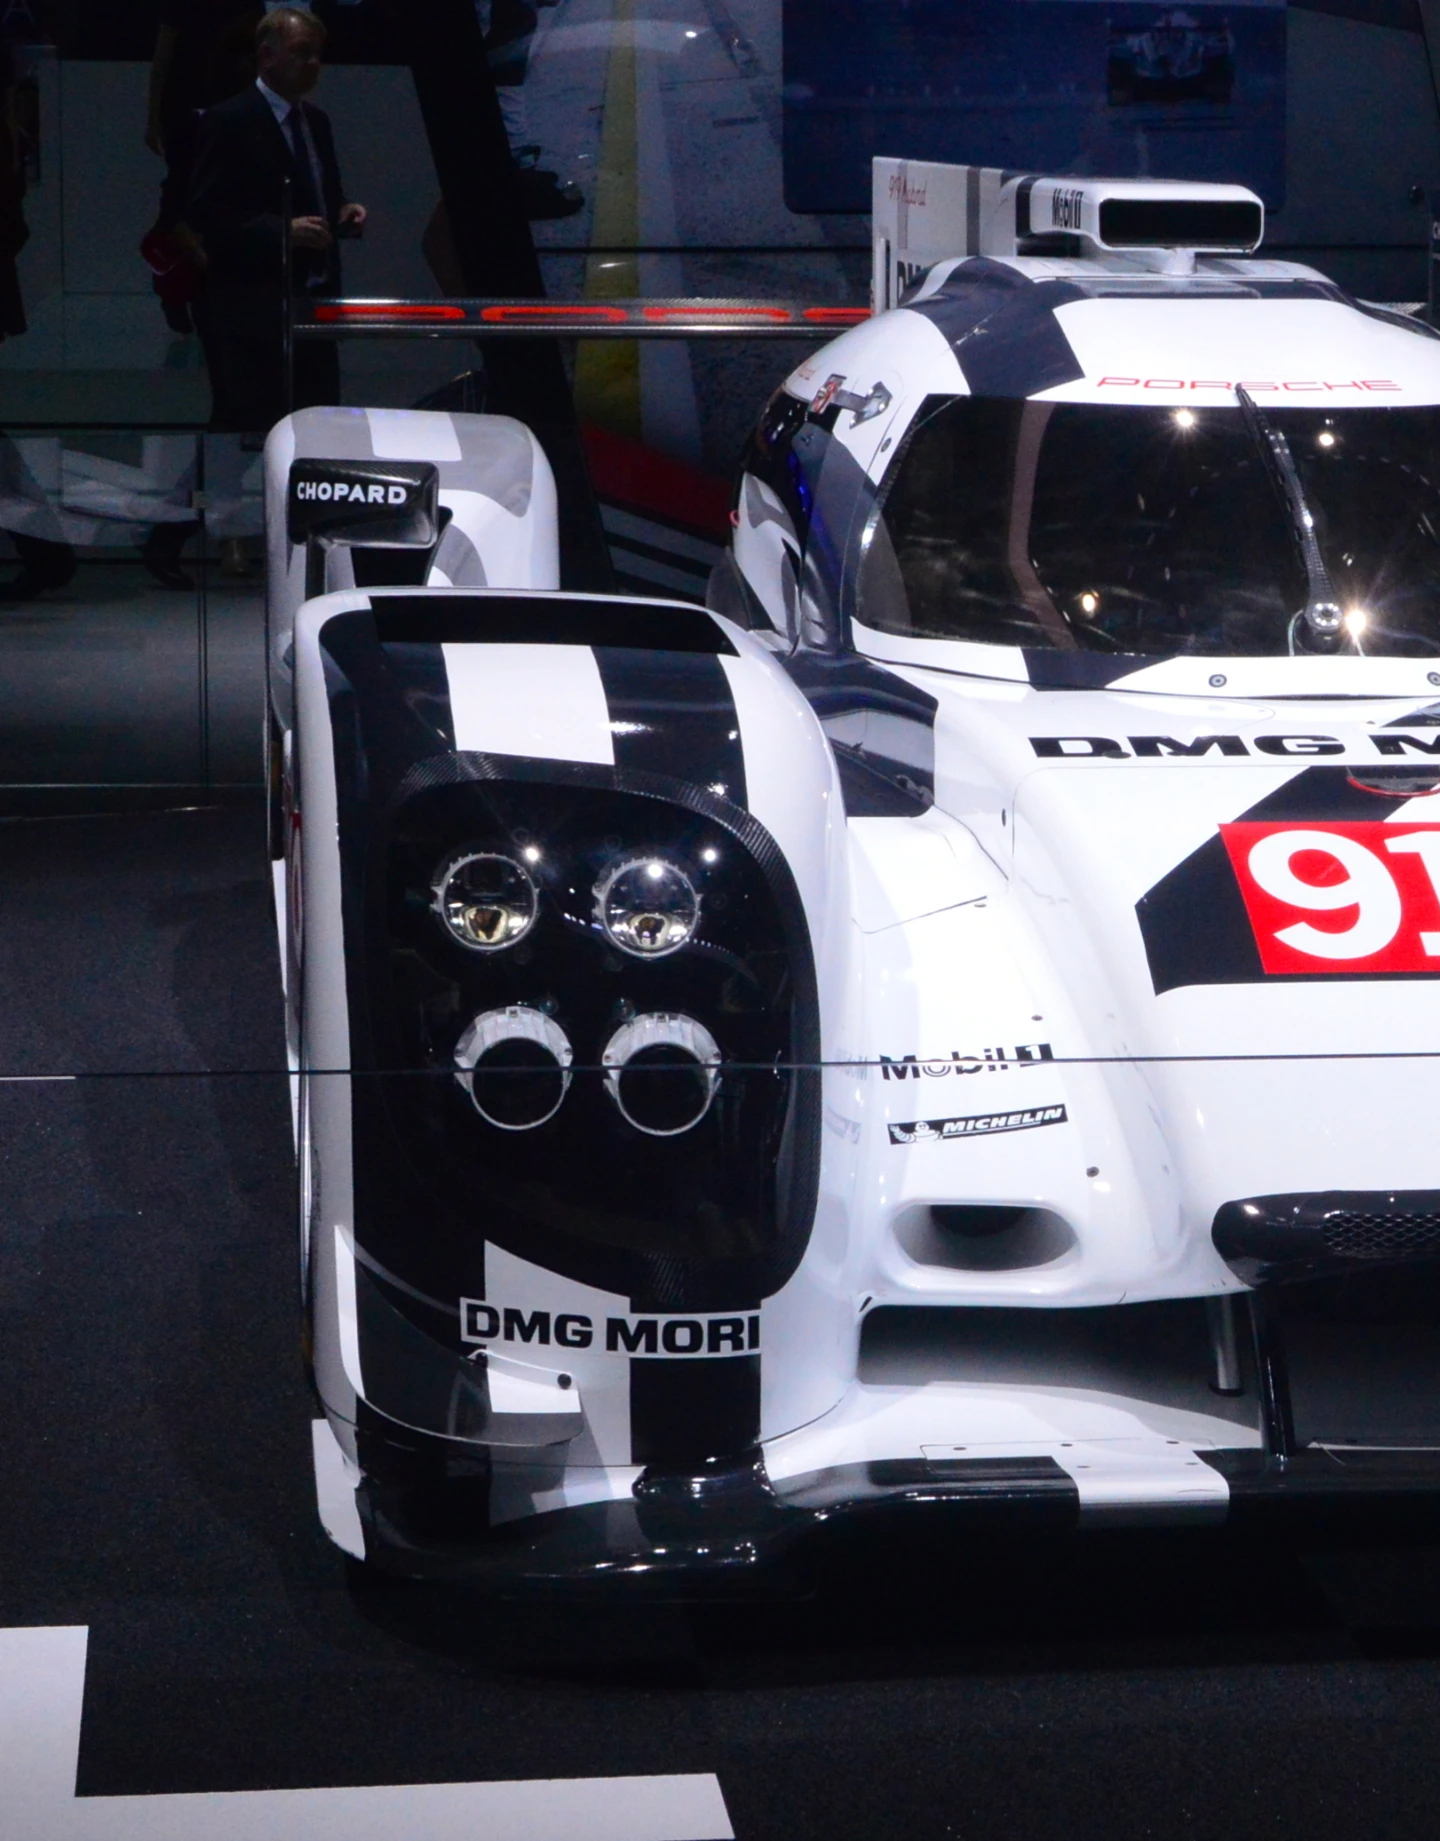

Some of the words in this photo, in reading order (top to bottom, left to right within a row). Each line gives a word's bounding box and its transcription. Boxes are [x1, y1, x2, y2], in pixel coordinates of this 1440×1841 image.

[1097, 376, 1402, 392] PORSCHE
[297, 482, 407, 504] CHOPARD
[1028, 735, 1346, 758] DMG
[943, 1107, 1063, 1134] MICHELIN
[466, 1303, 594, 1348] DMG
[606, 1315, 760, 1354] MORI
